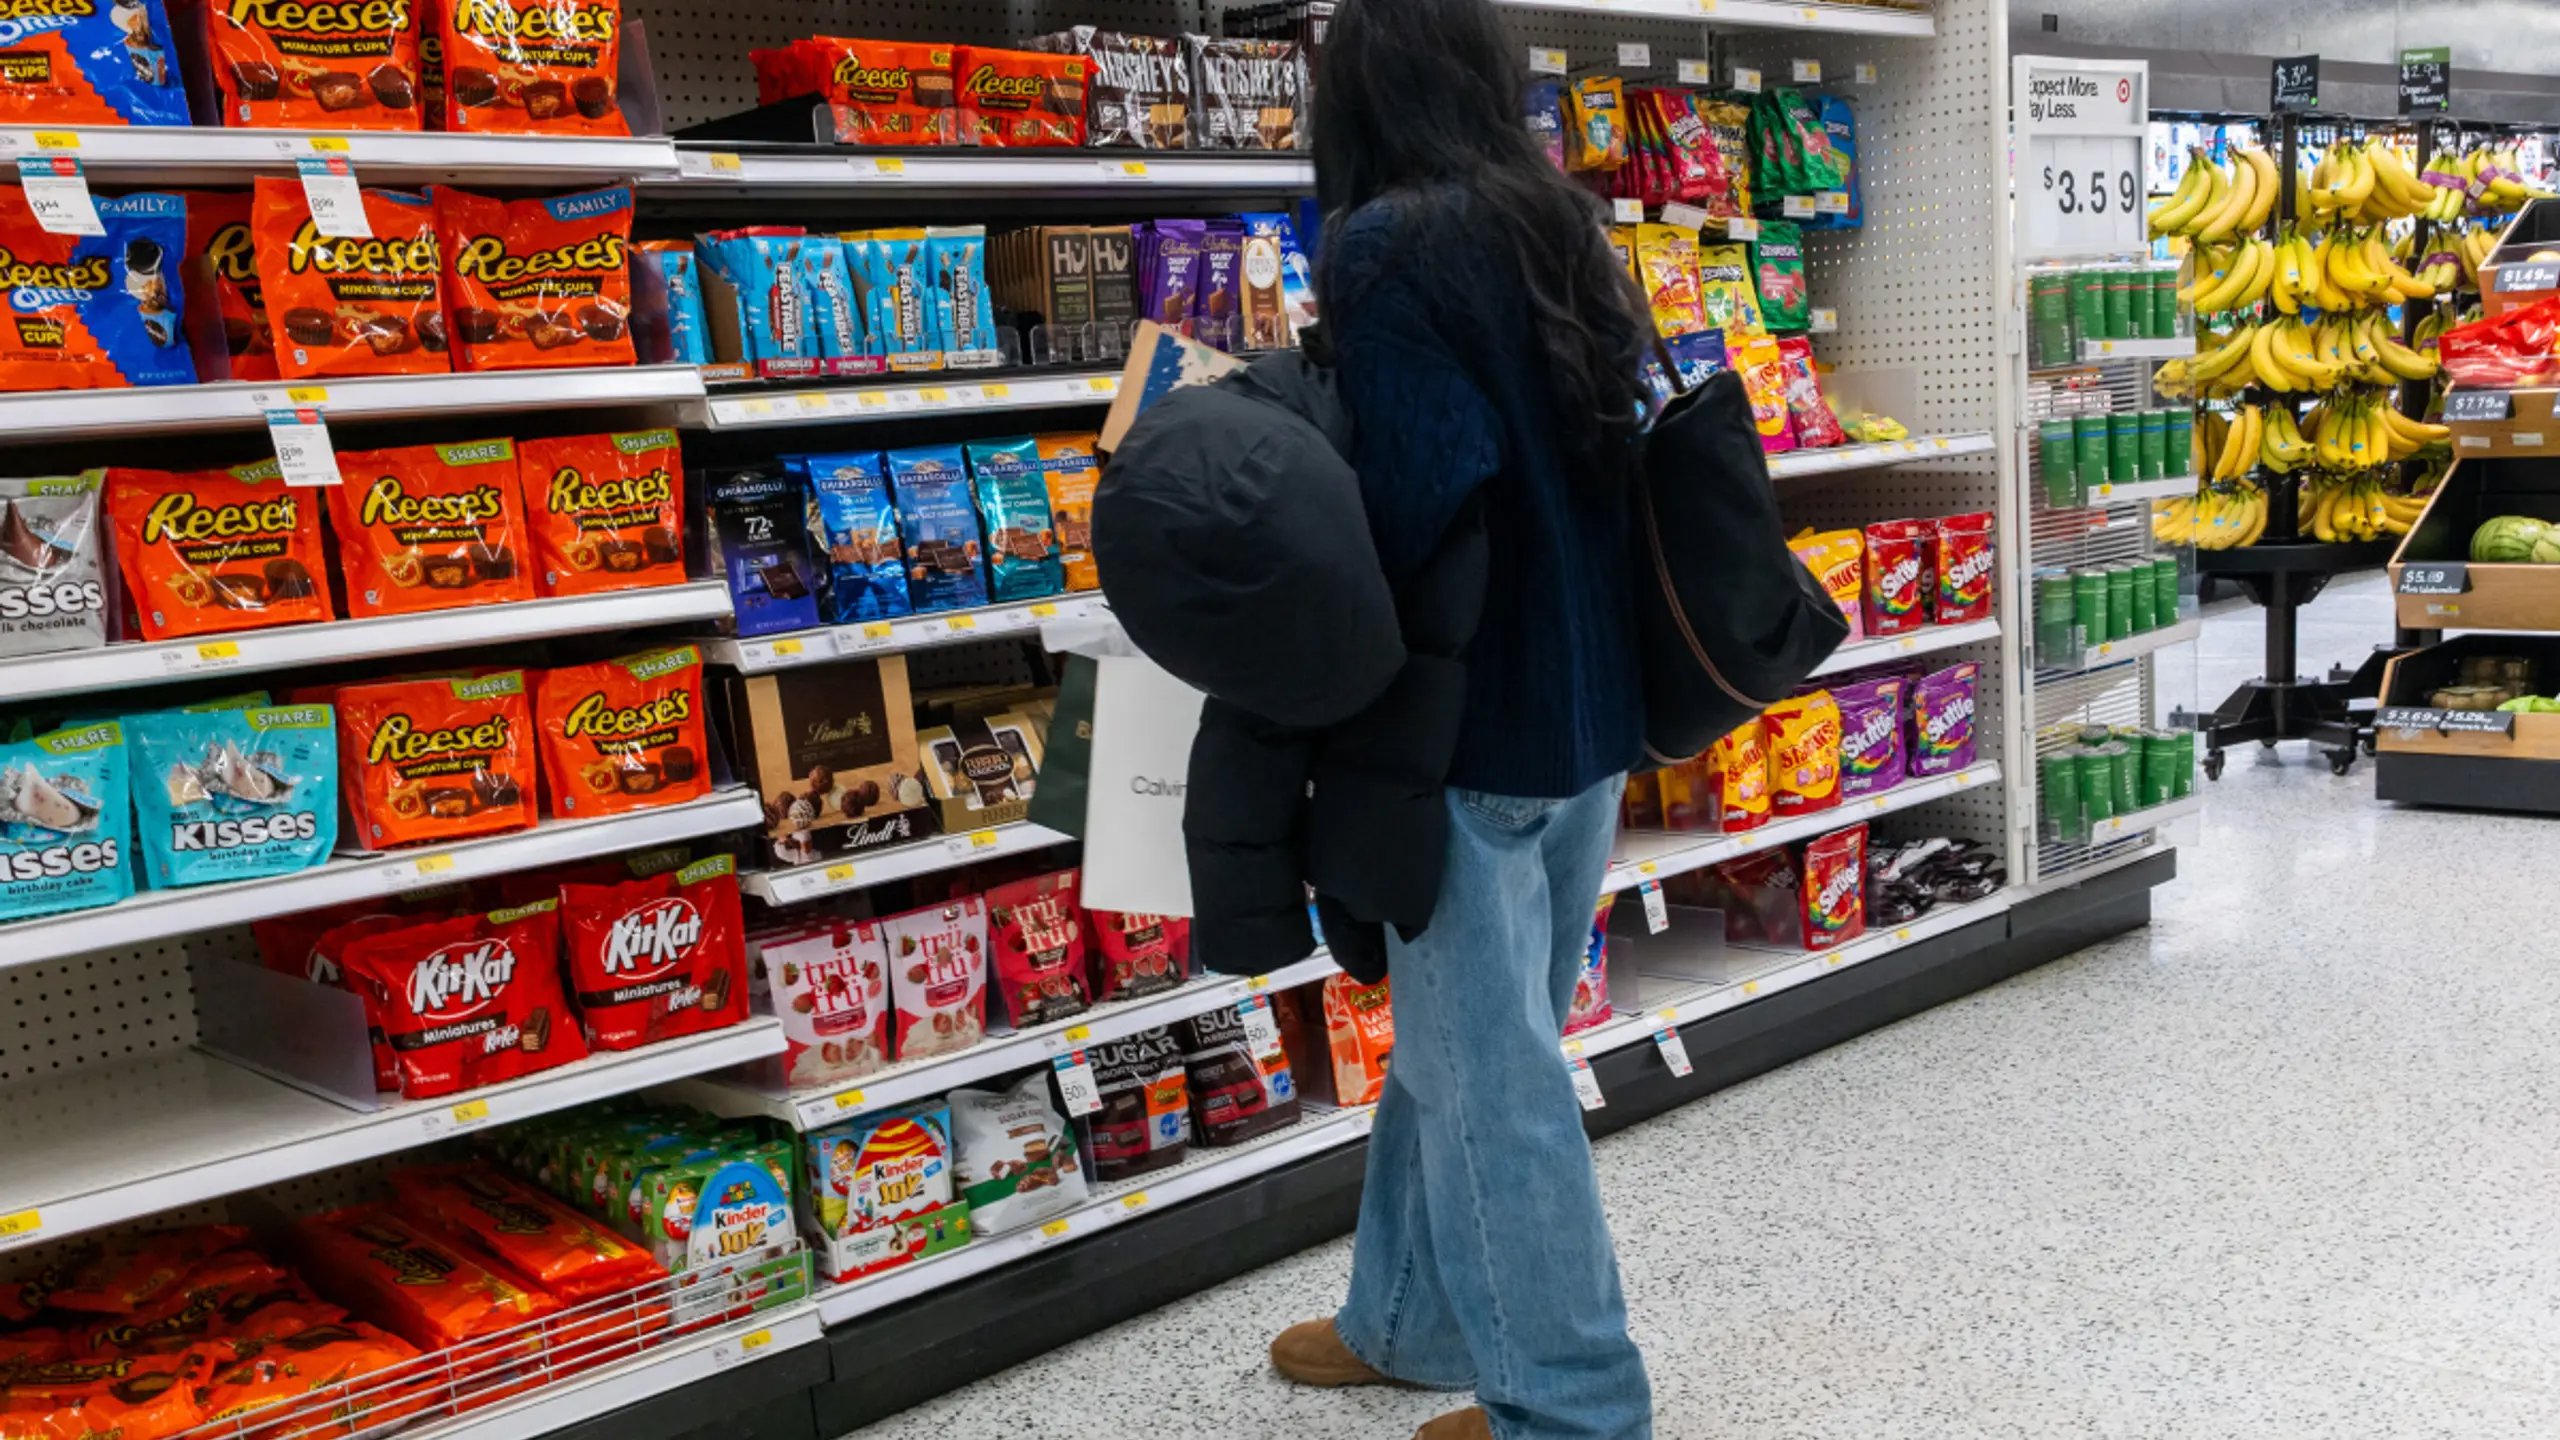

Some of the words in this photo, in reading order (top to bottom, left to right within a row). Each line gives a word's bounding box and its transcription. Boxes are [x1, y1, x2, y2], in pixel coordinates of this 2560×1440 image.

[281, 41, 351, 54] MINIATURE
[353, 41, 388, 53] CUPS
[564, 50, 591, 62] CUPS
[5, 66, 48, 78] CUPS
[834, 56, 911, 89] Reese's
[966, 65, 1044, 95] Reese's
[2047, 98, 2077, 118] Less.
[100, 198, 167, 213] FAMILY
[556, 193, 617, 215] FAMILY
[455, 233, 624, 283] Reese's
[565, 279, 595, 293] CUPS
[621, 433, 665, 451] SHARE
[447, 444, 496, 462] SHARE
[361, 475, 501, 525] Reese's
[549, 467, 672, 513] Reese's
[144, 493, 298, 543] Reese's
[252, 541, 282, 555] CUPS
[20, 616, 87, 631] chocolate
[637, 653, 689, 679] SHARE
[460, 680, 514, 697] SHARE
[257, 709, 315, 726] SHARE
[565, 690, 689, 738] Reese's
[51, 727, 112, 752] SHARE
[368, 714, 510, 765] Reese's
[843, 821, 897, 848] Lindt
[264, 843, 291, 855] cake
[8, 882, 63, 897] birthday
[66, 877, 94, 889] cake
[613, 978, 682, 1002] Miniatures
[422, 1017, 498, 1044] Miniatures
[1089, 1035, 1180, 1071] SUGAR
[1093, 1061, 1160, 1081] SSORTMENT
